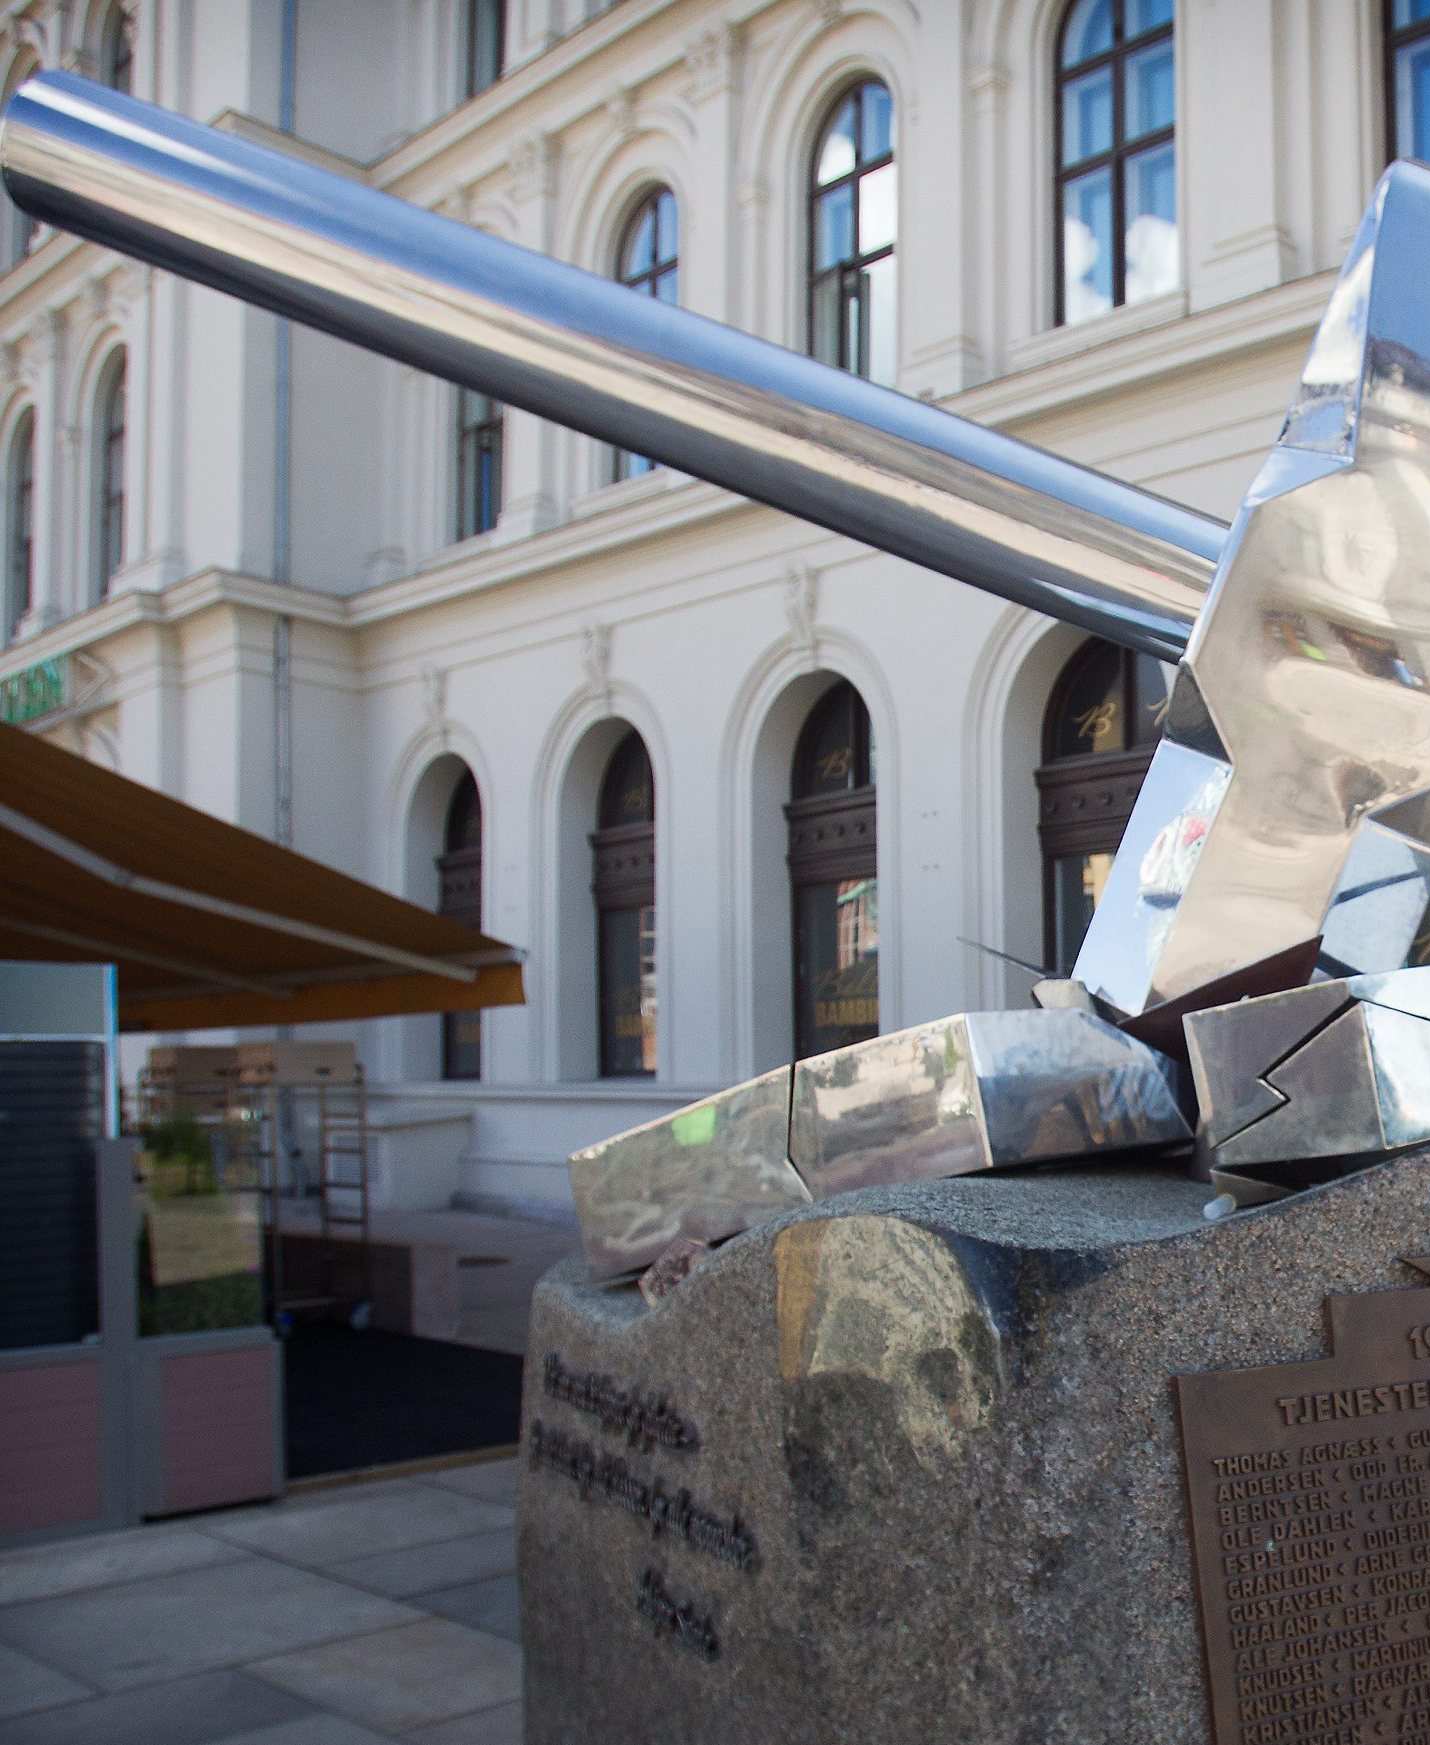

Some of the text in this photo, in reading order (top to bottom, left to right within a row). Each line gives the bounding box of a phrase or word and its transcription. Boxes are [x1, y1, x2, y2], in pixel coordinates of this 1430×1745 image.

[1212, 1450, 1295, 1478] THOMAS
[1301, 1437, 1381, 1466] AGNÆSS
[1218, 1468, 1326, 1502] ANDERSEN
[1350, 1460, 1389, 1482] ODD
[1219, 1491, 1333, 1527] BERNTSEN
[1222, 1527, 1261, 1551] OLE
[1273, 1509, 1357, 1542] DAHLEN
[1224, 1539, 1338, 1576] ESPELUND
[1226, 1565, 1333, 1600] GRANLUND
[1355, 1551, 1401, 1576] ARNE
[1229, 1585, 1348, 1625] GUSTAVSEN
[1231, 1614, 1320, 1650] HAALAND
[1343, 1602, 1379, 1625] PER
[1237, 1648, 1278, 1674] ALF
[1283, 1623, 1388, 1663] JOHANSEN
[1237, 1659, 1327, 1697] KNUDSEN
[1239, 1683, 1329, 1722] KNUTSEN
[1352, 1661, 1430, 1696] RAGNAR
[1241, 1698, 1379, 1745] KRISTIANSEN
